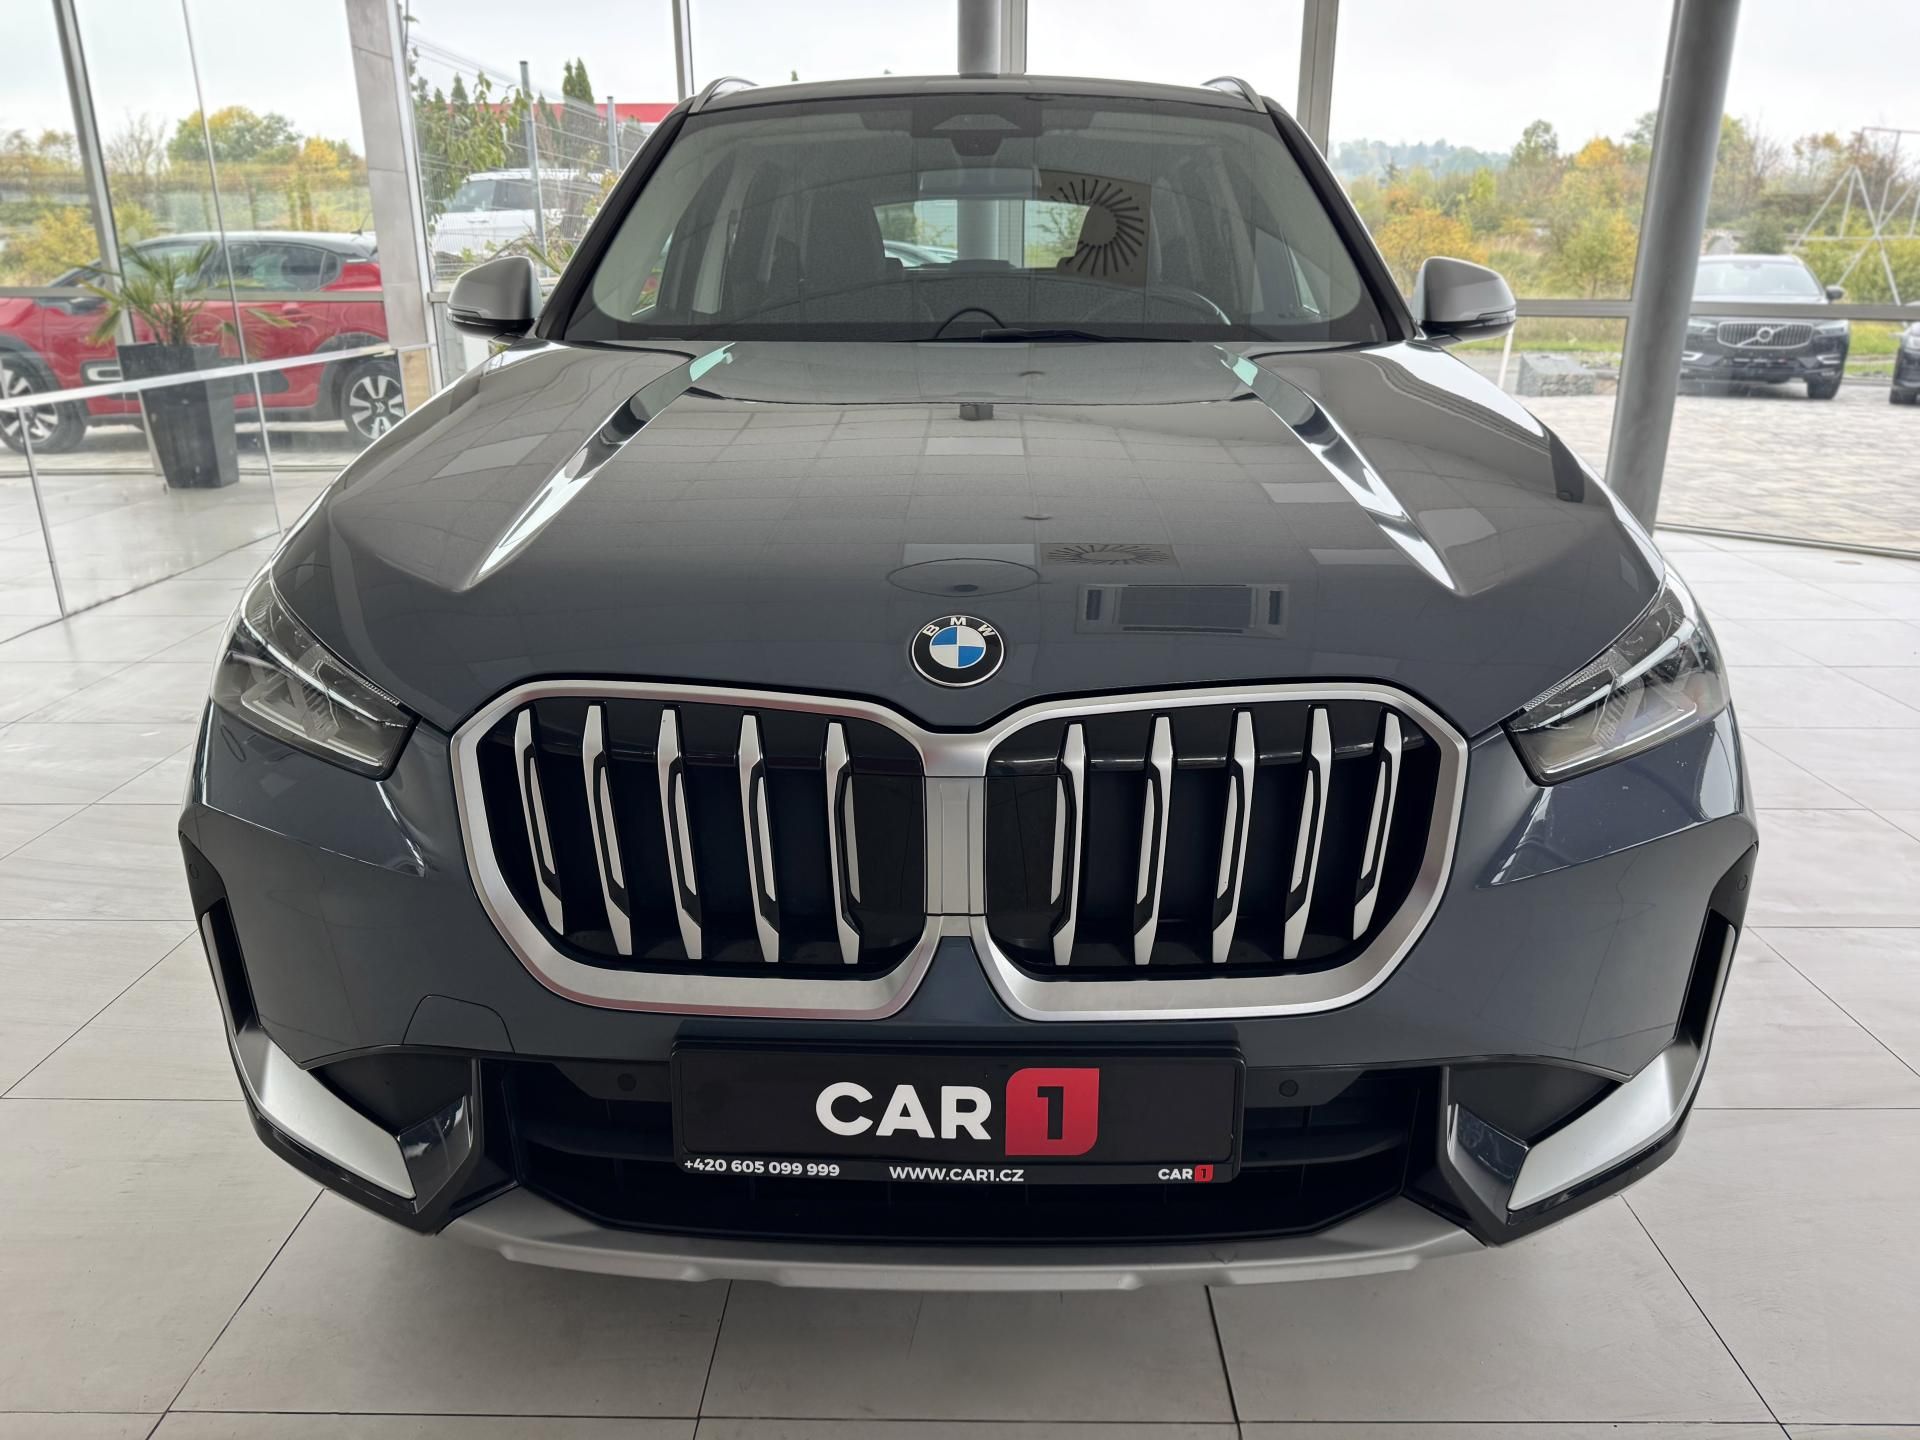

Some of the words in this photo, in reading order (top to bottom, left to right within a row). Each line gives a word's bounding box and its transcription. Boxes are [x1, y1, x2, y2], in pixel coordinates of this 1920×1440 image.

[922, 616, 996, 637] BMW
[684, 1158, 727, 1172] +420
[731, 1160, 765, 1174] 605
[768, 1161, 803, 1175] 099
[806, 1163, 840, 1177] 999
[888, 1166, 1025, 1182] WWW.CAR1.CZ
